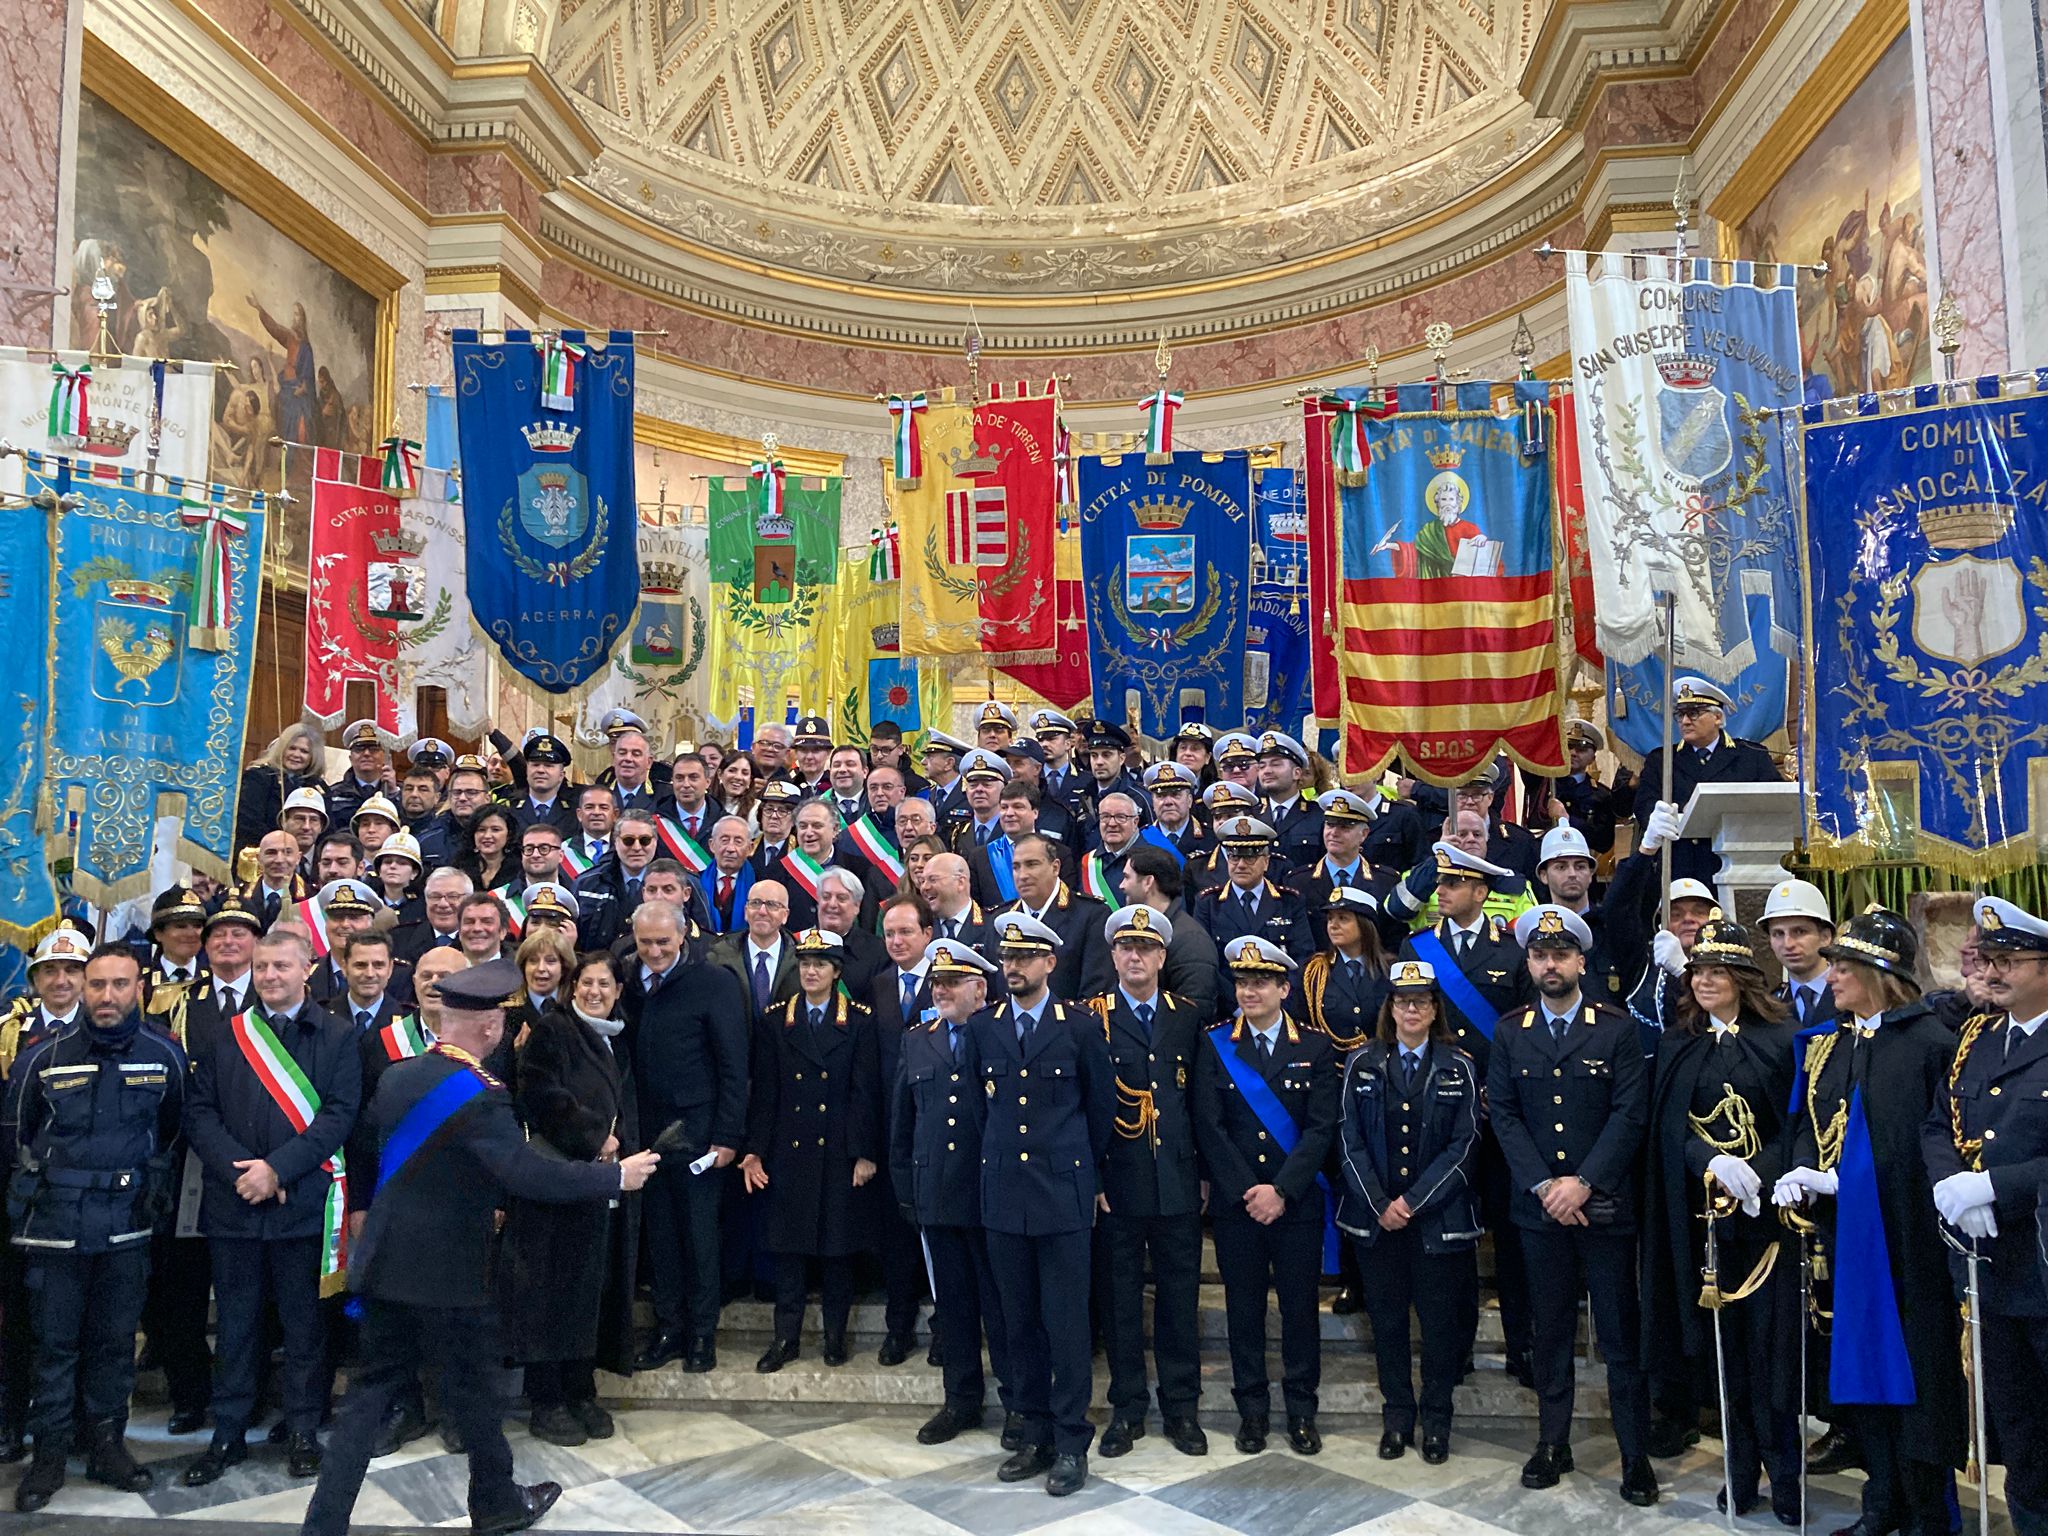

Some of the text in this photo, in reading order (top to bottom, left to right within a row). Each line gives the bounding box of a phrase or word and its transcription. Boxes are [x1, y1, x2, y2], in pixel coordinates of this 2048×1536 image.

[1639, 287, 1723, 313] COMUNE
[1578, 324, 1799, 392] SAN GIUSEPPE VESUVIANO
[122, 384, 136, 397] DI
[90, 394, 187, 440] MONTE LNGO
[1901, 411, 2028, 452] COMUNE
[987, 413, 1008, 429] DE'
[1009, 420, 1043, 464] TIRRENI
[1370, 427, 1414, 464] ITTA'
[1423, 429, 1437, 444] DI
[1954, 448, 1974, 466] DI
[1083, 471, 1246, 524] CITTA' DI POMPEI
[1853, 469, 2048, 530] MANOCALZA
[330, 504, 466, 547] CITTA' DI BARONISS
[639, 538, 653, 553] DI
[520, 609, 597, 623] ACERRA
